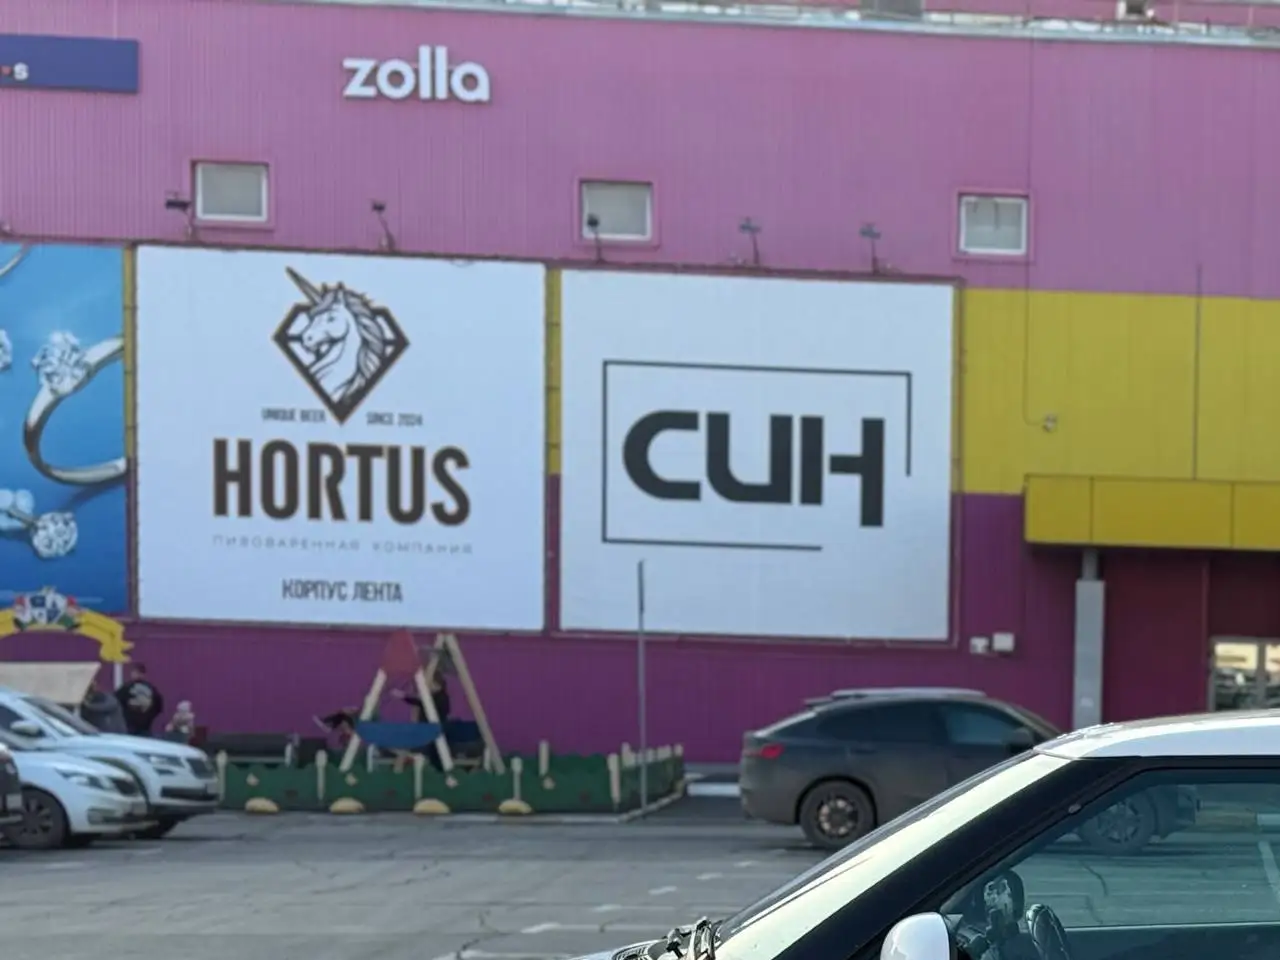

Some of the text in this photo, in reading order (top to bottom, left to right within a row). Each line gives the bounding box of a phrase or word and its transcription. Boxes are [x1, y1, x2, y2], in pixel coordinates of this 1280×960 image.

[342, 45, 490, 102] zolla
[213, 437, 471, 527] HORTUS
[211, 533, 474, 556] ПИВОВАРЕННАЯ КОМПАНИЯ
[281, 577, 404, 603] КОРПУС ЛЕНТА
